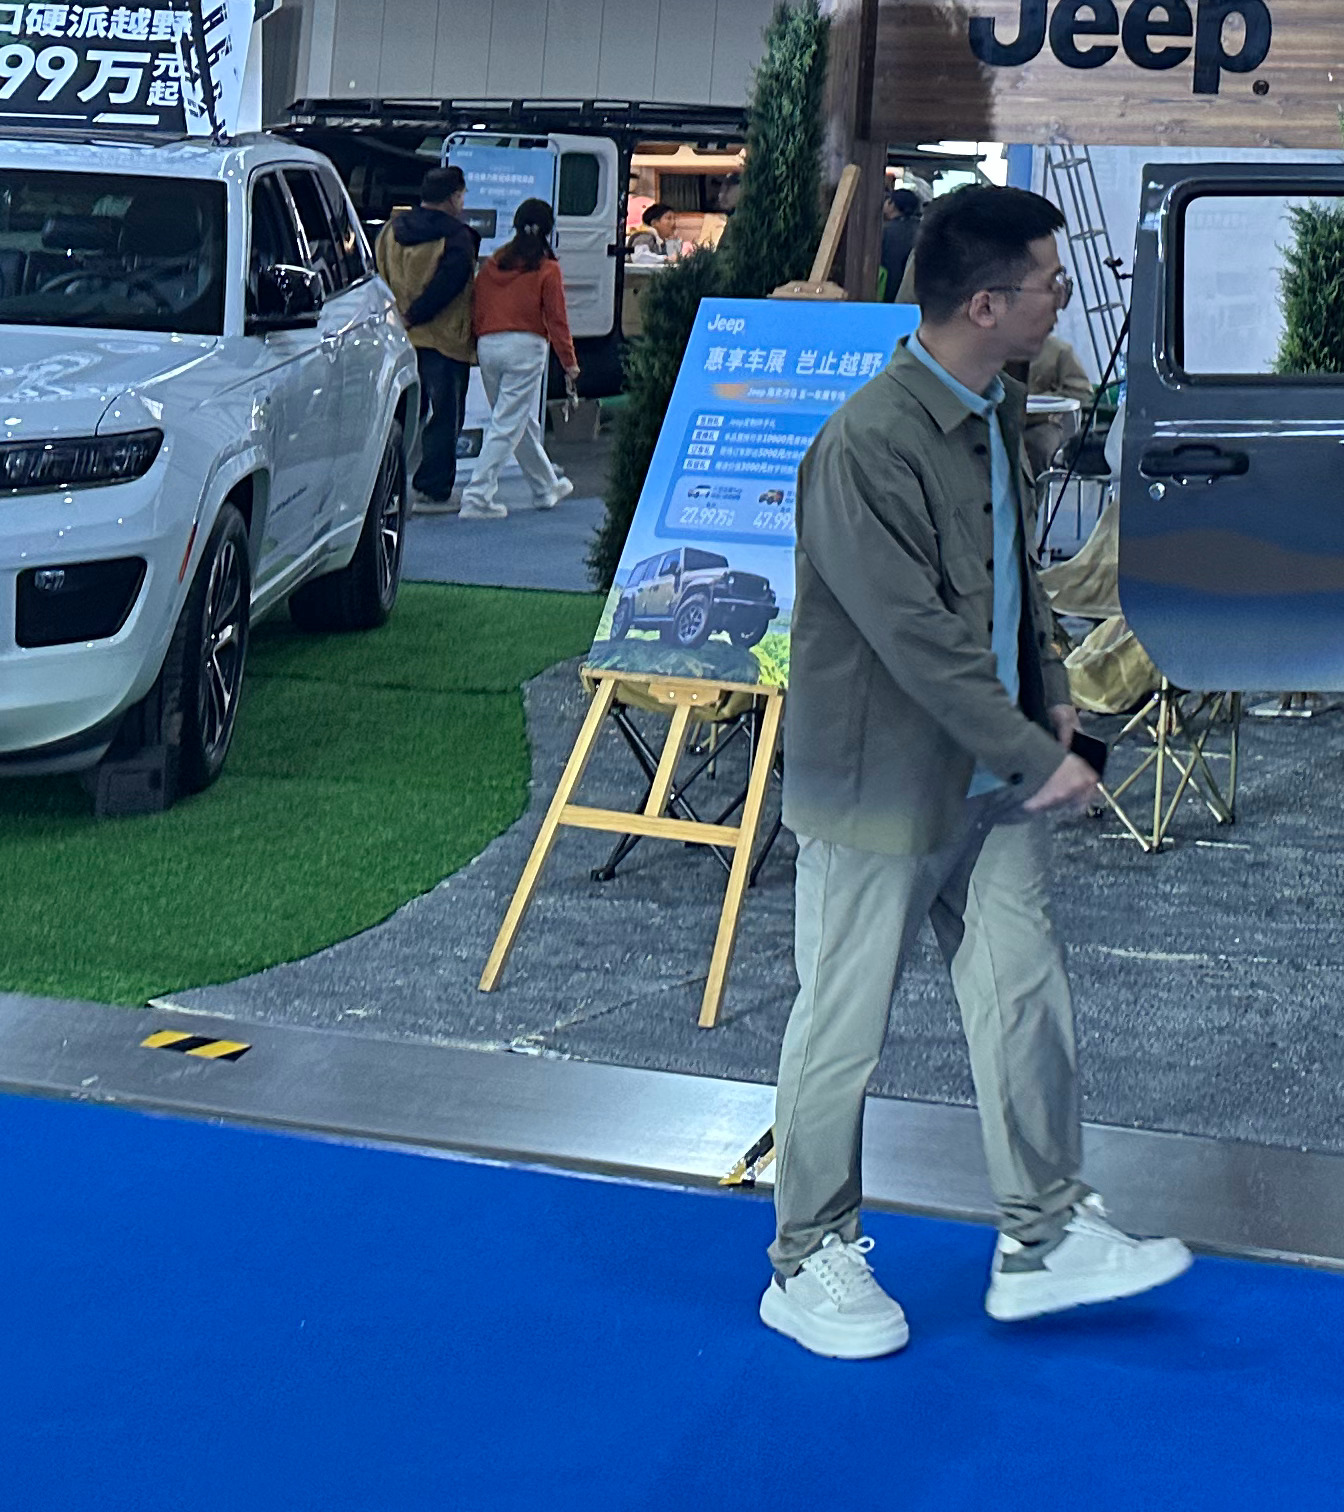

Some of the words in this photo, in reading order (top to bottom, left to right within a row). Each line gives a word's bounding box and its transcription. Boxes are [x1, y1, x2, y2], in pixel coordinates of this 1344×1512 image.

[708, 313, 745, 335] Jeep
[704, 346, 787, 373] 惠享车展
[795, 350, 884, 378] 岂止越野
[753, 511, 796, 531] 47.99
